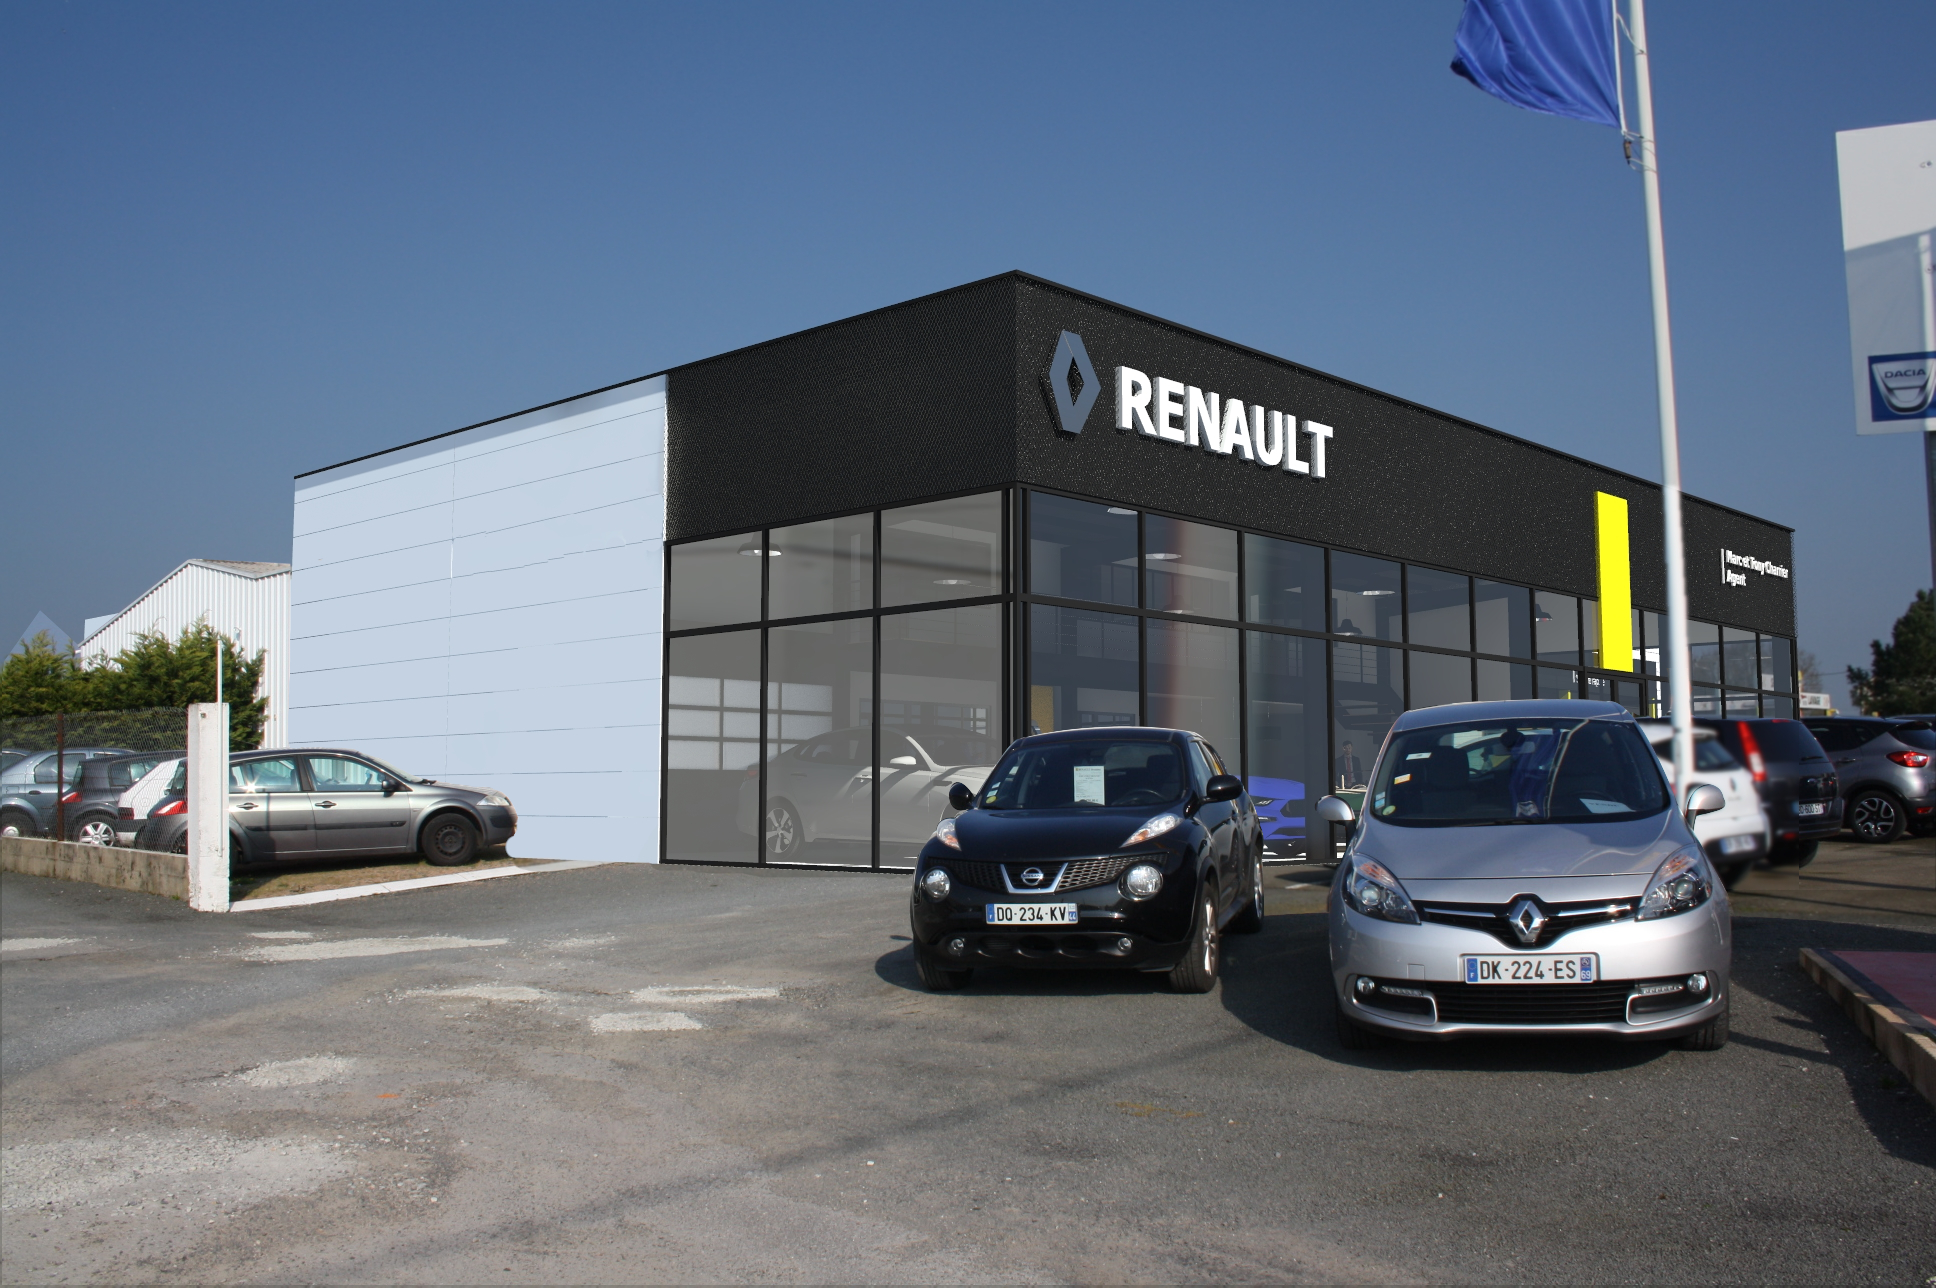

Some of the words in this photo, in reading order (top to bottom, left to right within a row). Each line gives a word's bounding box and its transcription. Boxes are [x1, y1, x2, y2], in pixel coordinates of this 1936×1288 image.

[1884, 368, 1926, 379] DACIA
[1115, 365, 1333, 479] RENAULT
[1726, 550, 1743, 567] Marc
[1749, 556, 1765, 575] Tony
[1726, 569, 1747, 587] Agent
[996, 906, 1066, 922] DQ-234-KV
[1479, 960, 1576, 980] DK-224-ES
[1581, 970, 1591, 980] 69
